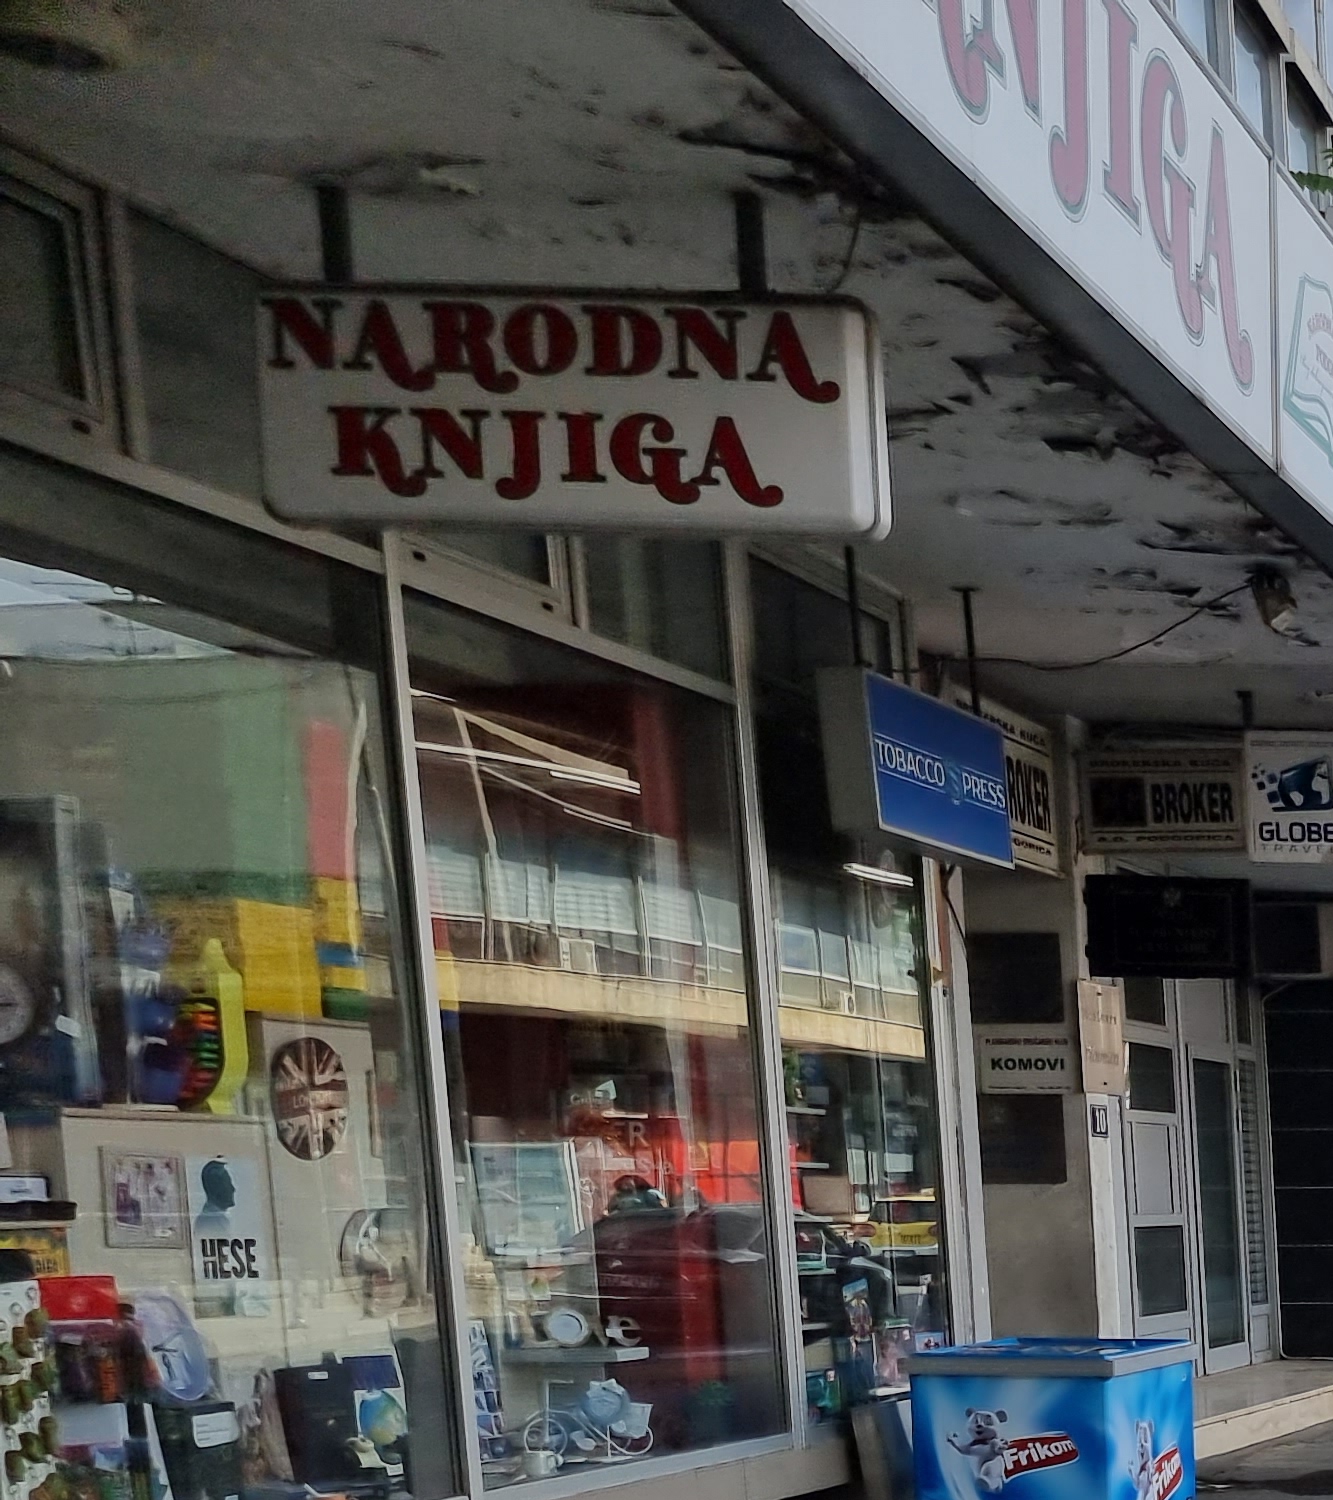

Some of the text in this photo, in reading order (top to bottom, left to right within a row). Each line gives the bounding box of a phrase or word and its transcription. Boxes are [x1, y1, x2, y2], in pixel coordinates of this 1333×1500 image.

[937, 0, 1254, 396] JIGA
[262, 300, 841, 404] NARODNA
[328, 405, 785, 508] KNJIGA
[874, 738, 946, 787] TOBACCO
[961, 772, 1007, 810] PRESS
[1005, 754, 1052, 835] ROKER
[1151, 782, 1235, 825] BROKER
[990, 1057, 1065, 1071] KOMOVI
[1095, 1107, 1106, 1133] 10
[200, 1238, 260, 1280] HESE
[1003, 1438, 1077, 1471] Frikom
